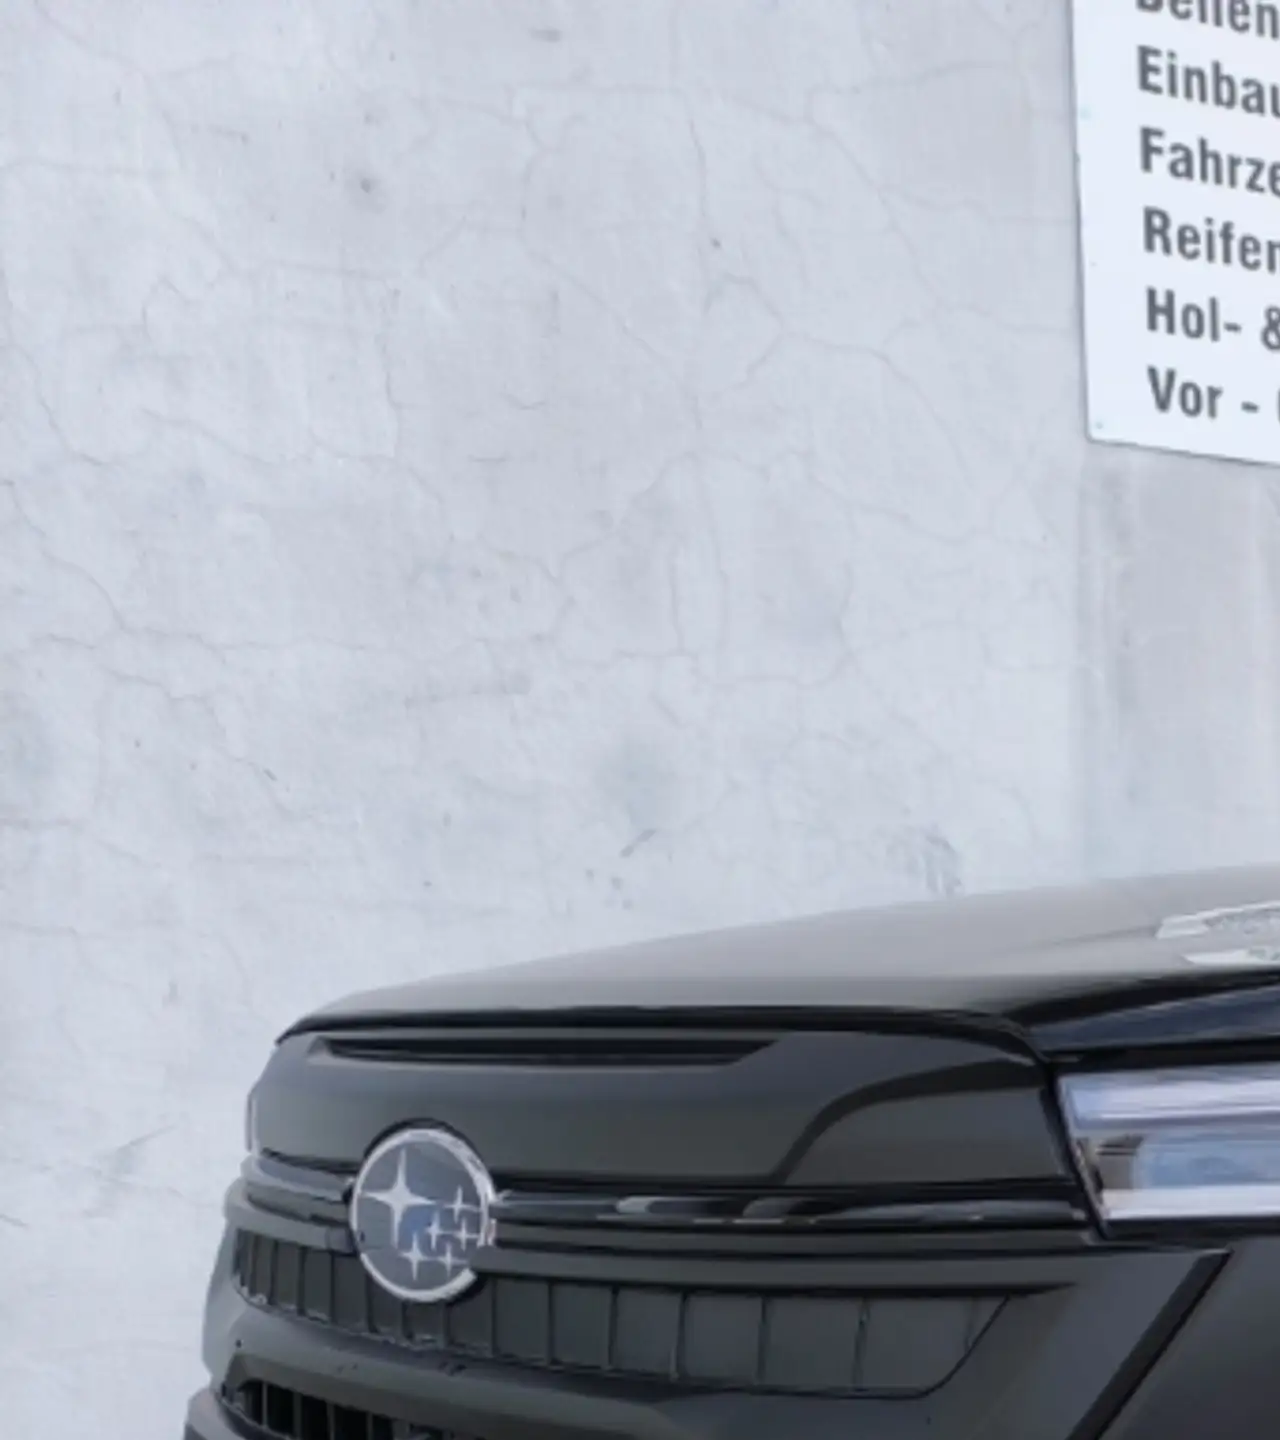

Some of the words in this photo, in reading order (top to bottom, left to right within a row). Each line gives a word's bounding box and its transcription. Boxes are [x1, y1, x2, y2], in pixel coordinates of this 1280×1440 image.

[1135, 0, 1280, 41] ellen
[1146, 286, 1243, 343] Hol-
[1147, 365, 1224, 419] Vor
